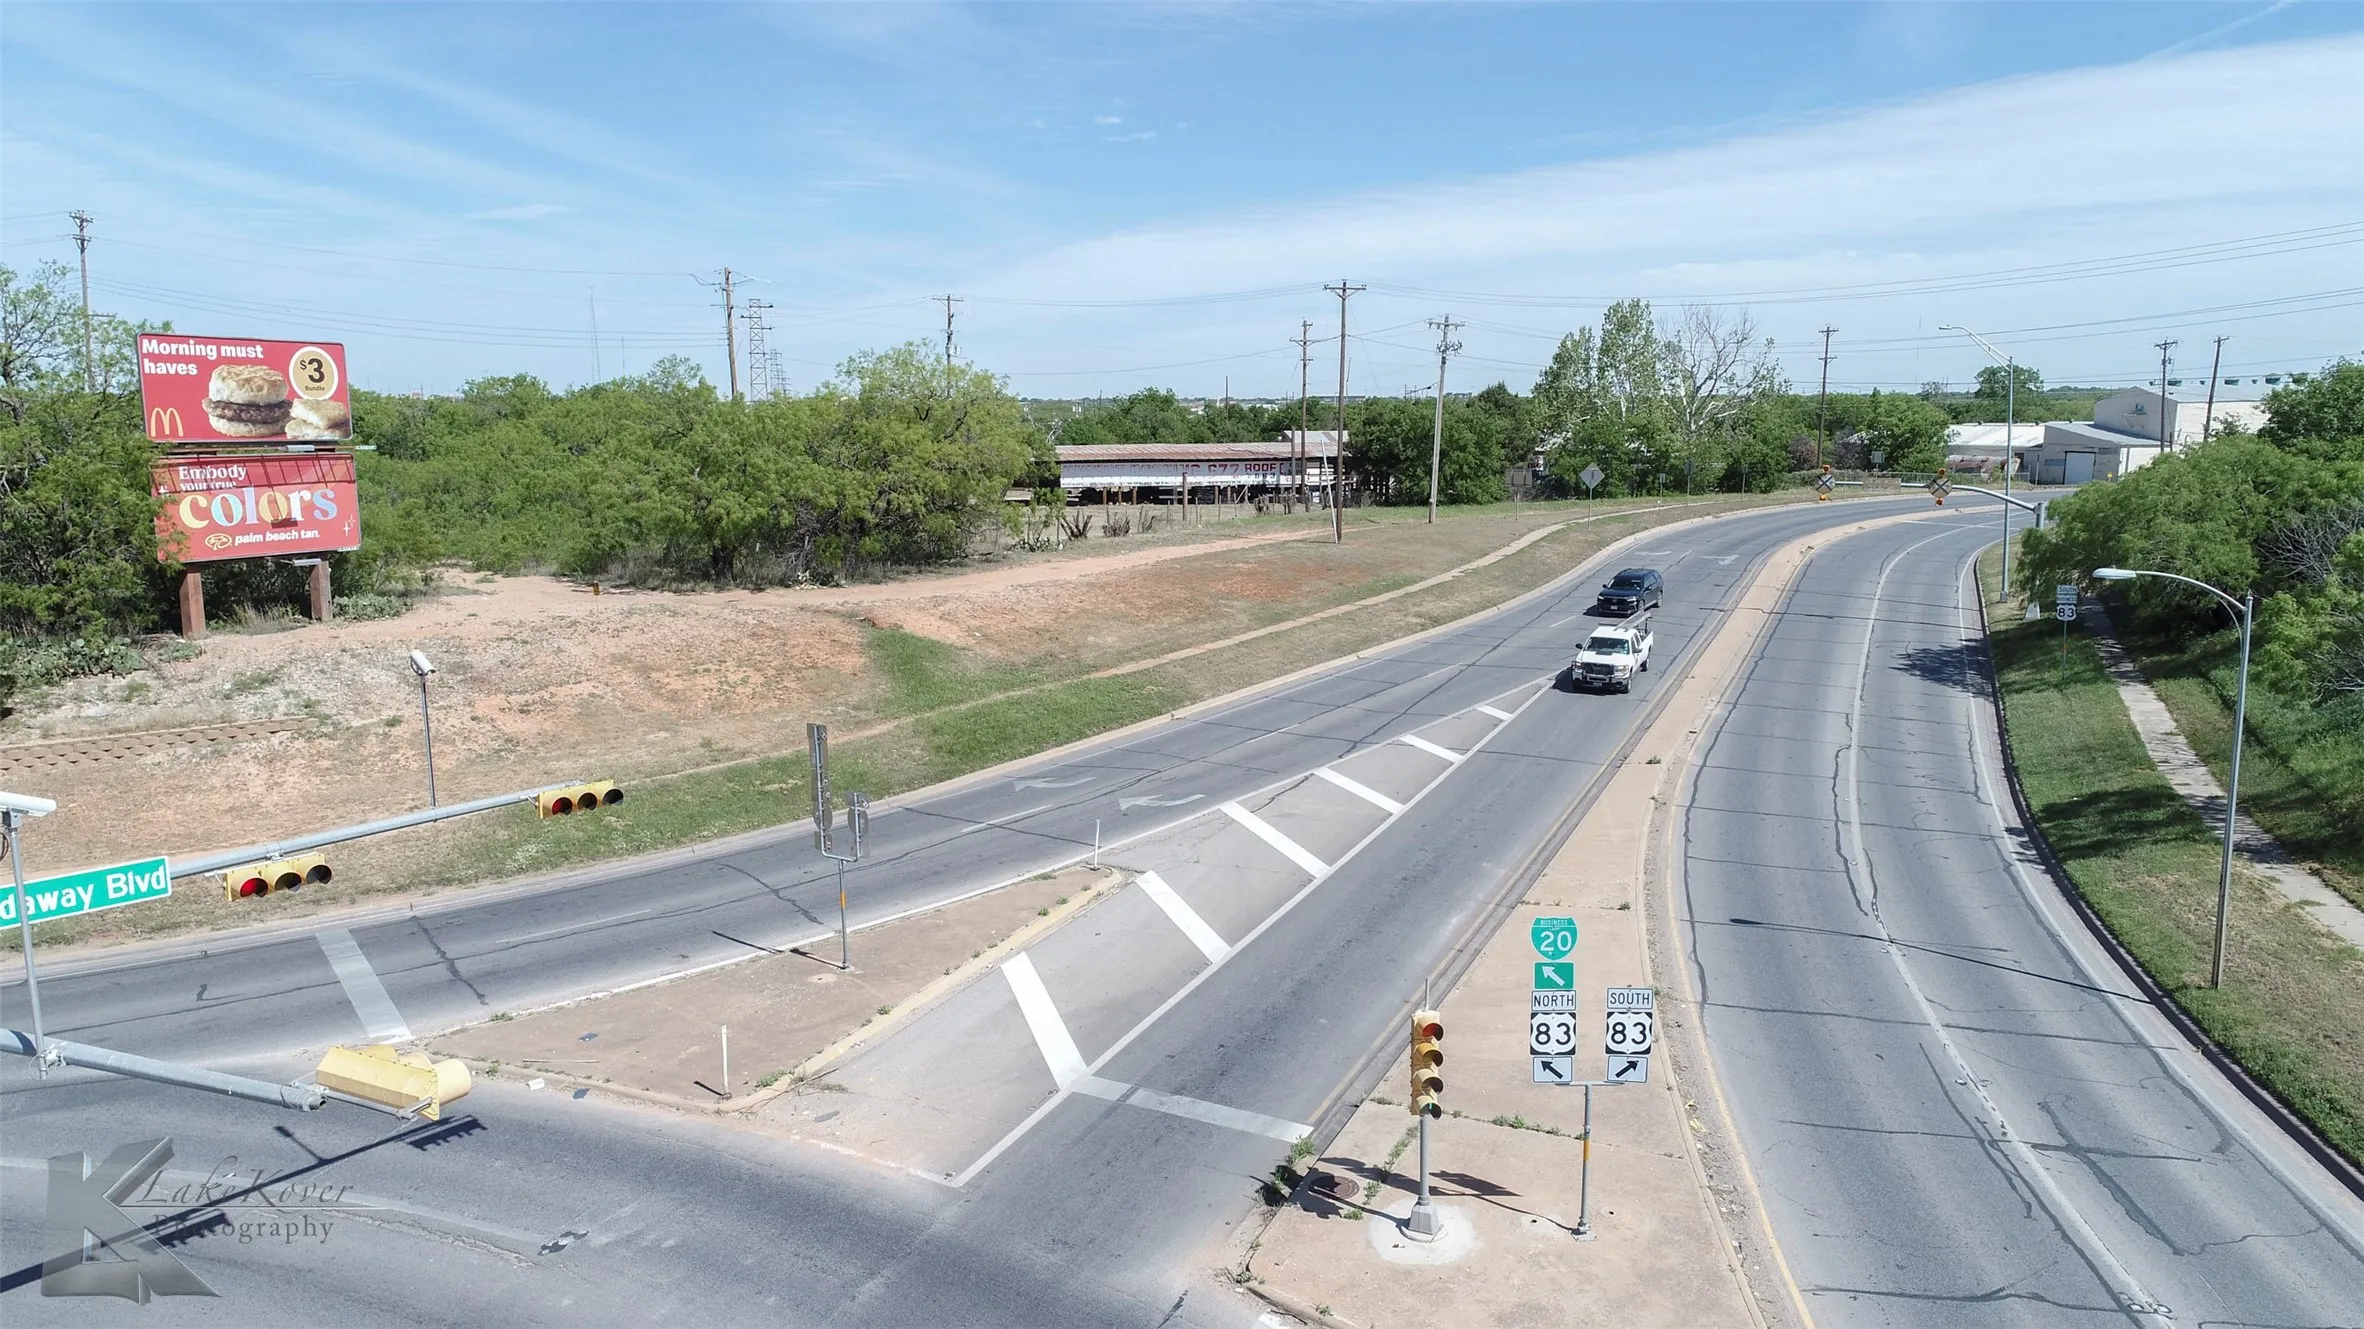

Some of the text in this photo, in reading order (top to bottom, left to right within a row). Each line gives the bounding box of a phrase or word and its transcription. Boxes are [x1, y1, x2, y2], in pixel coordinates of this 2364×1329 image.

[142, 338, 264, 360] Morning must
[143, 358, 198, 375] haves
[178, 465, 247, 480] Embody
[1244, 463, 1277, 473] ROOF
[180, 480, 237, 492] your true
[178, 485, 338, 529] colors
[234, 532, 264, 546] palm
[265, 530, 299, 542] beach
[2058, 607, 2075, 618] 83
[106, 865, 167, 899] Blvd
[1540, 931, 1572, 951] 20
[1533, 995, 1574, 1007] NORTH
[1609, 992, 1650, 1005] SOUTH
[1535, 1022, 1571, 1045] 83
[1611, 1021, 1647, 1045] 83
